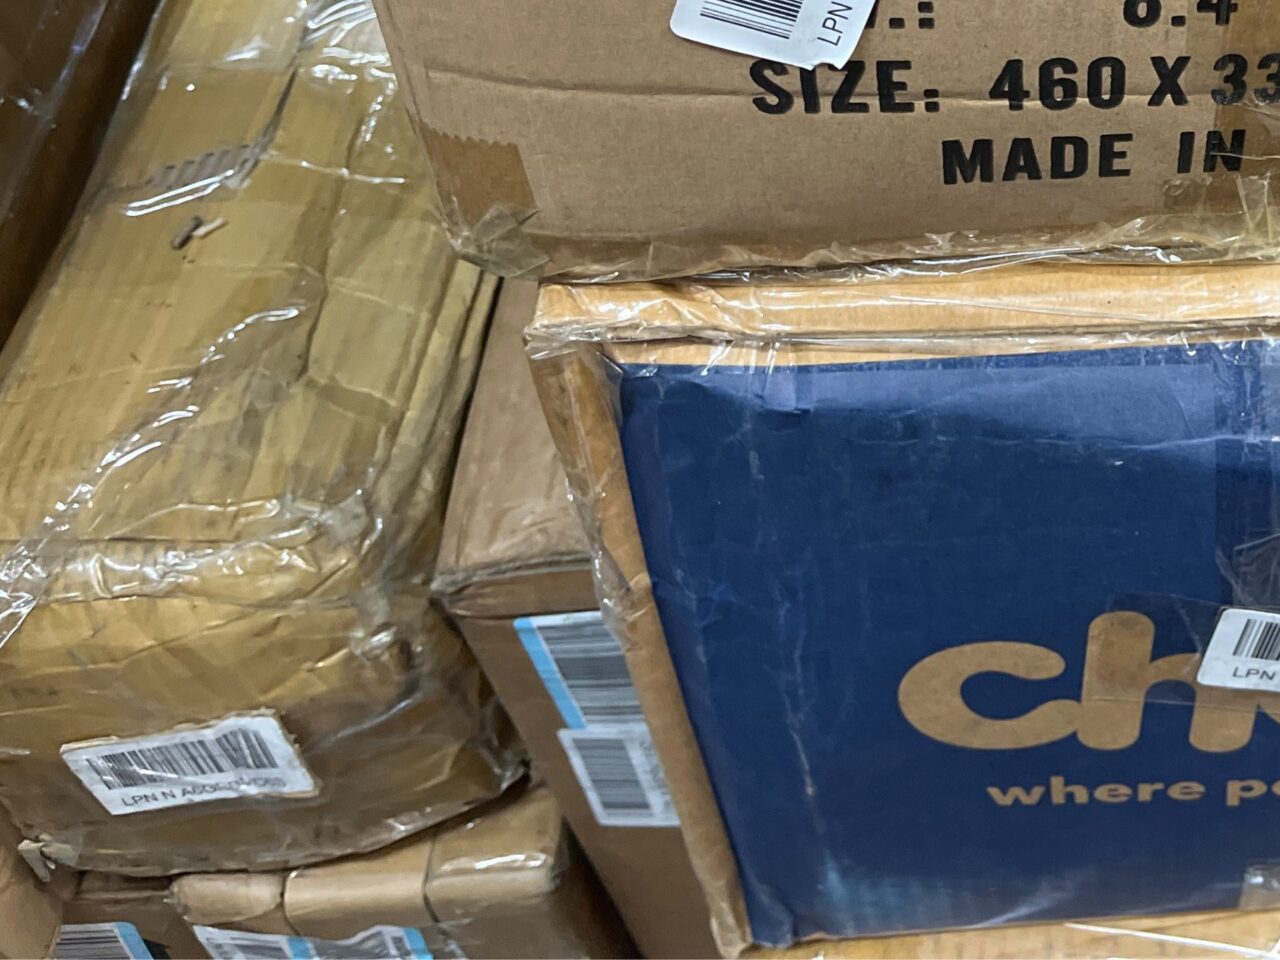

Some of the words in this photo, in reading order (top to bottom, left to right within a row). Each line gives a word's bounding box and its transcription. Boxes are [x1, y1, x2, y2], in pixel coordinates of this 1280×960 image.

[816, 1, 853, 47] LPN
[749, 57, 940, 115] SIZE:
[988, 55, 1127, 112] 460
[941, 132, 1134, 186] MADE
[1176, 128, 1247, 174] IN
[1231, 666, 1277, 682] LPN
[121, 793, 159, 808] LPN
[987, 775, 1206, 807] where
